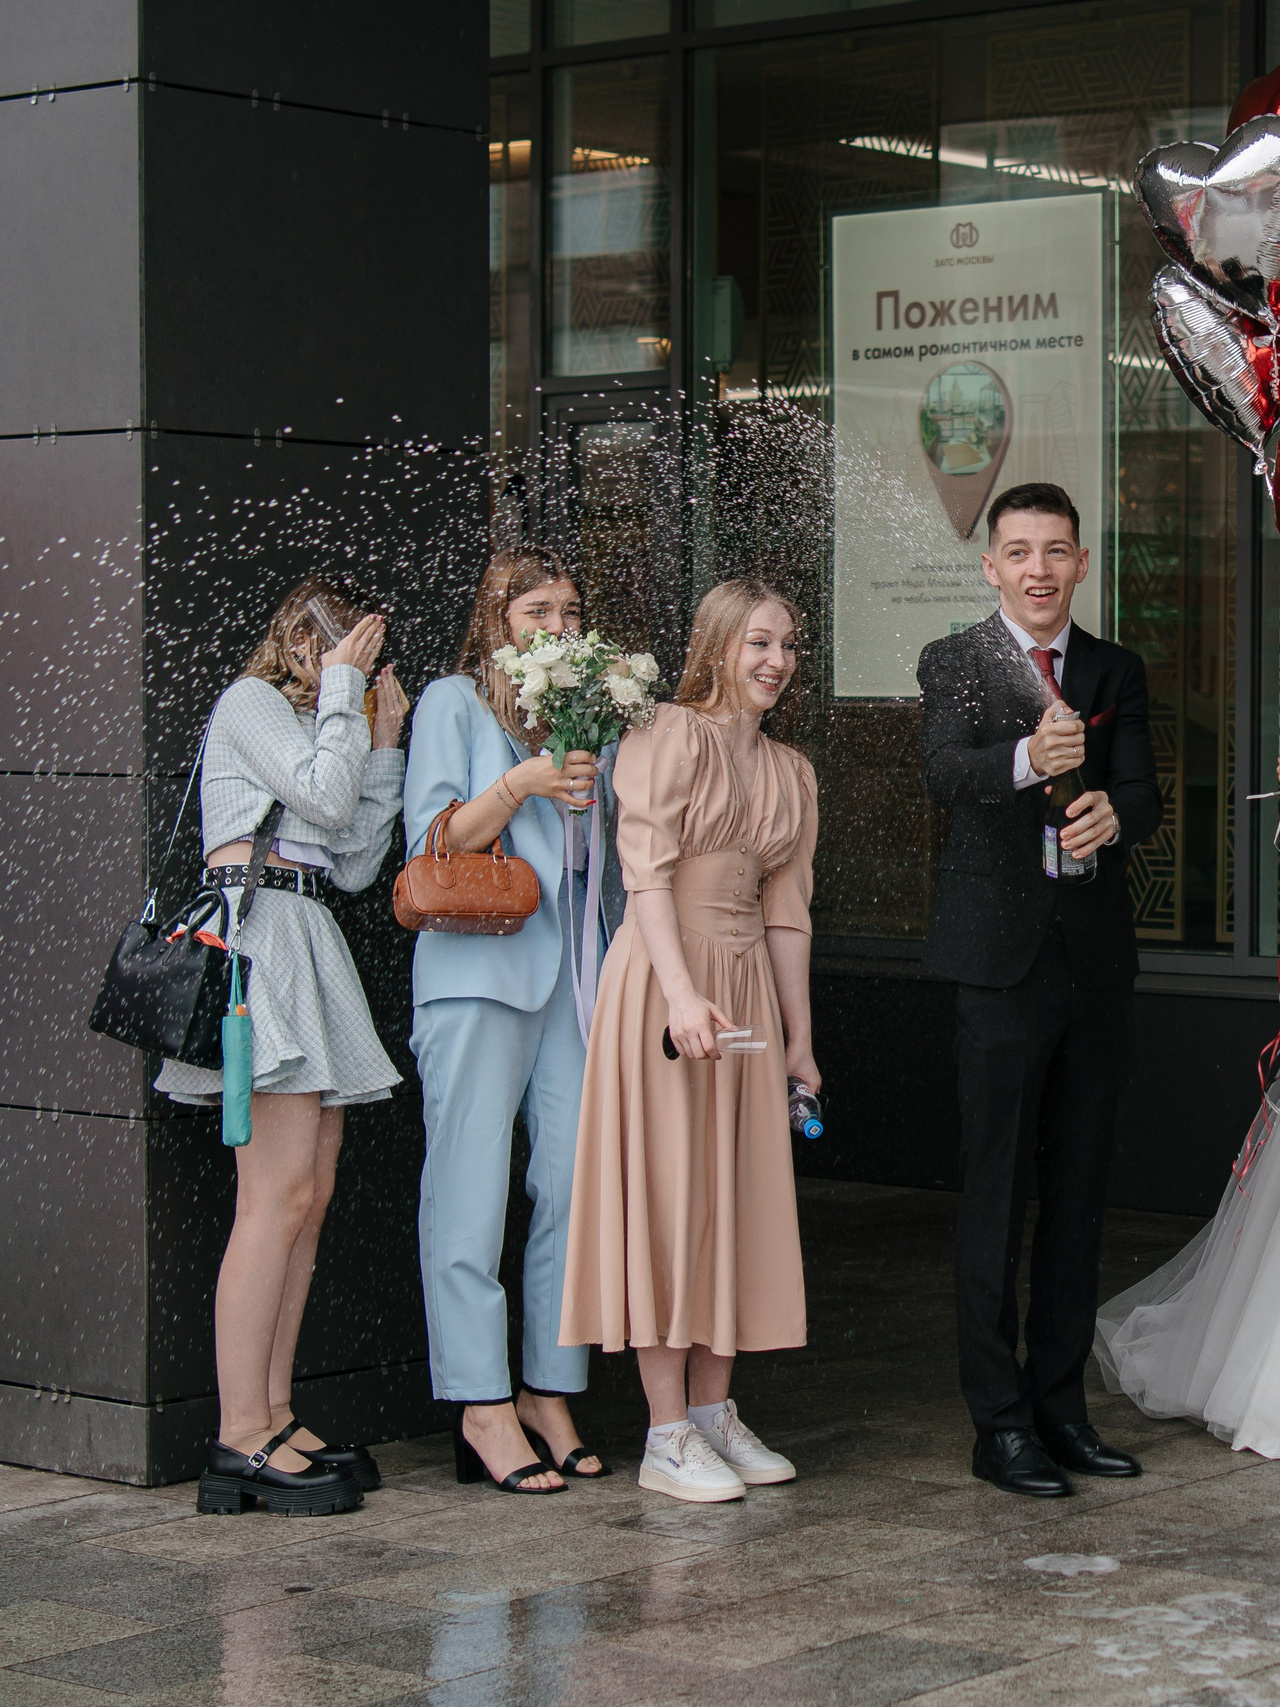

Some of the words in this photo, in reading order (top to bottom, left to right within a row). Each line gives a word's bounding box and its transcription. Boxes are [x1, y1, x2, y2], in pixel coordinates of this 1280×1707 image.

[875, 289, 1060, 331] Поженим
[851, 348, 860, 361] в
[864, 346, 914, 360] самом
[918, 337, 1032, 362] романтичном
[1035, 334, 1084, 349] месте
